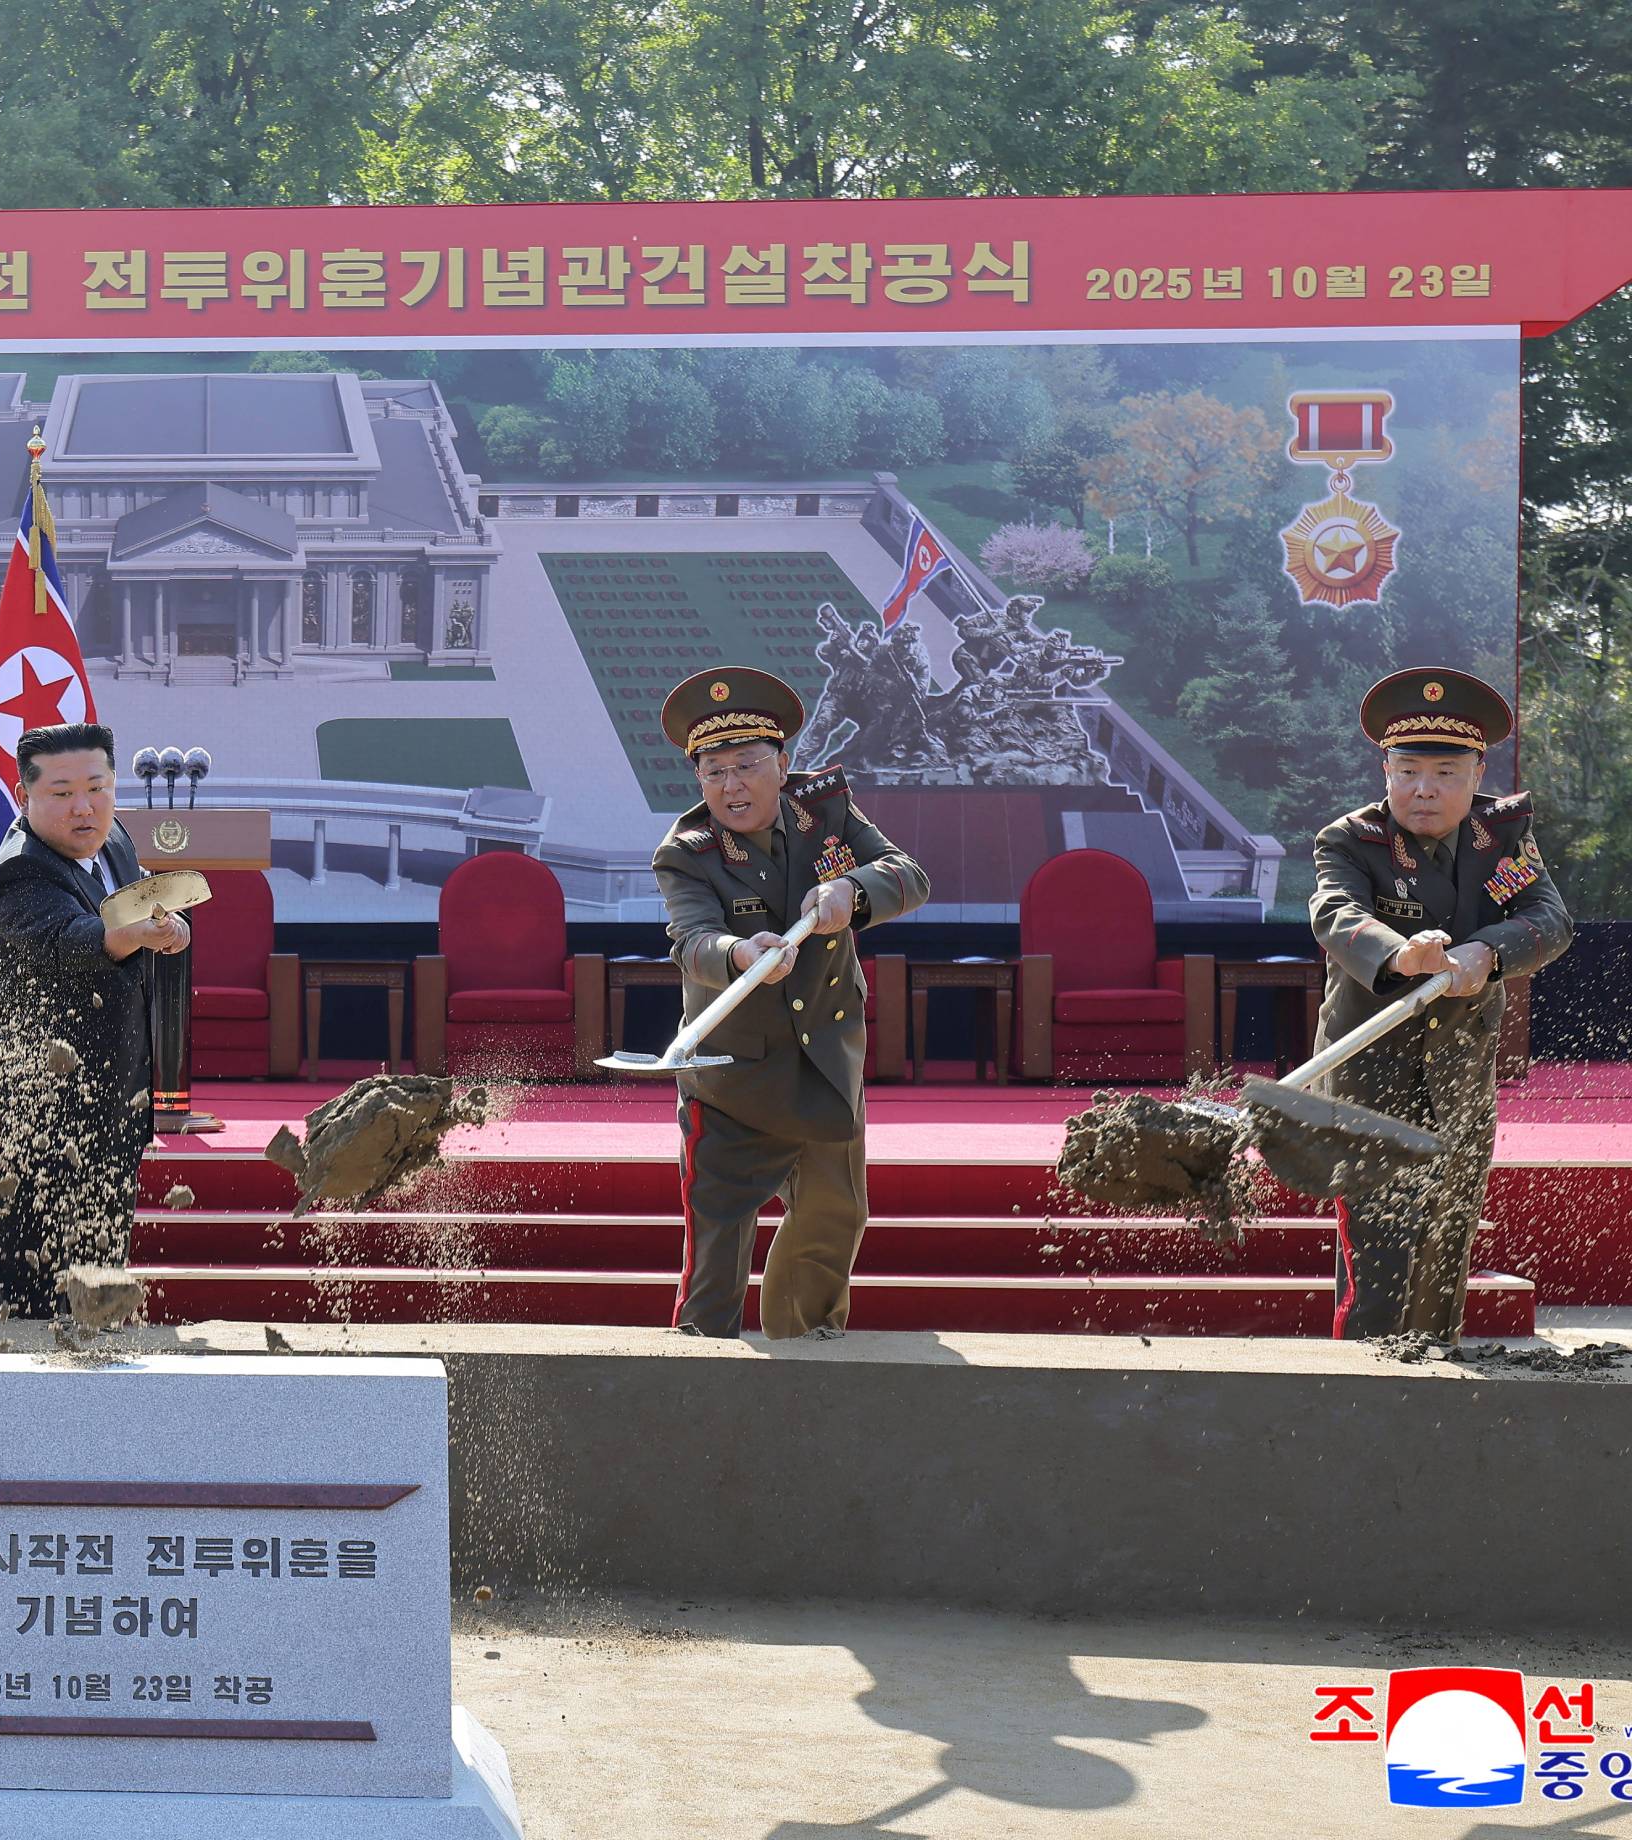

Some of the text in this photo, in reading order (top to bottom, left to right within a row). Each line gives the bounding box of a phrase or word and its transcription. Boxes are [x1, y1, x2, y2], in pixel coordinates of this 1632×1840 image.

[82, 240, 1031, 309] 전투위훈기념관건설착공식
[1086, 267, 1243, 300] 2025년
[1268, 265, 1367, 298] 10월
[1389, 264, 1491, 298] 23일
[146, 1535, 379, 1580] 전투위훈을
[15, 1595, 199, 1639] 기념하여
[52, 1673, 112, 1703] 10월
[132, 1674, 192, 1703] 23일
[213, 1675, 274, 1706] 착공
